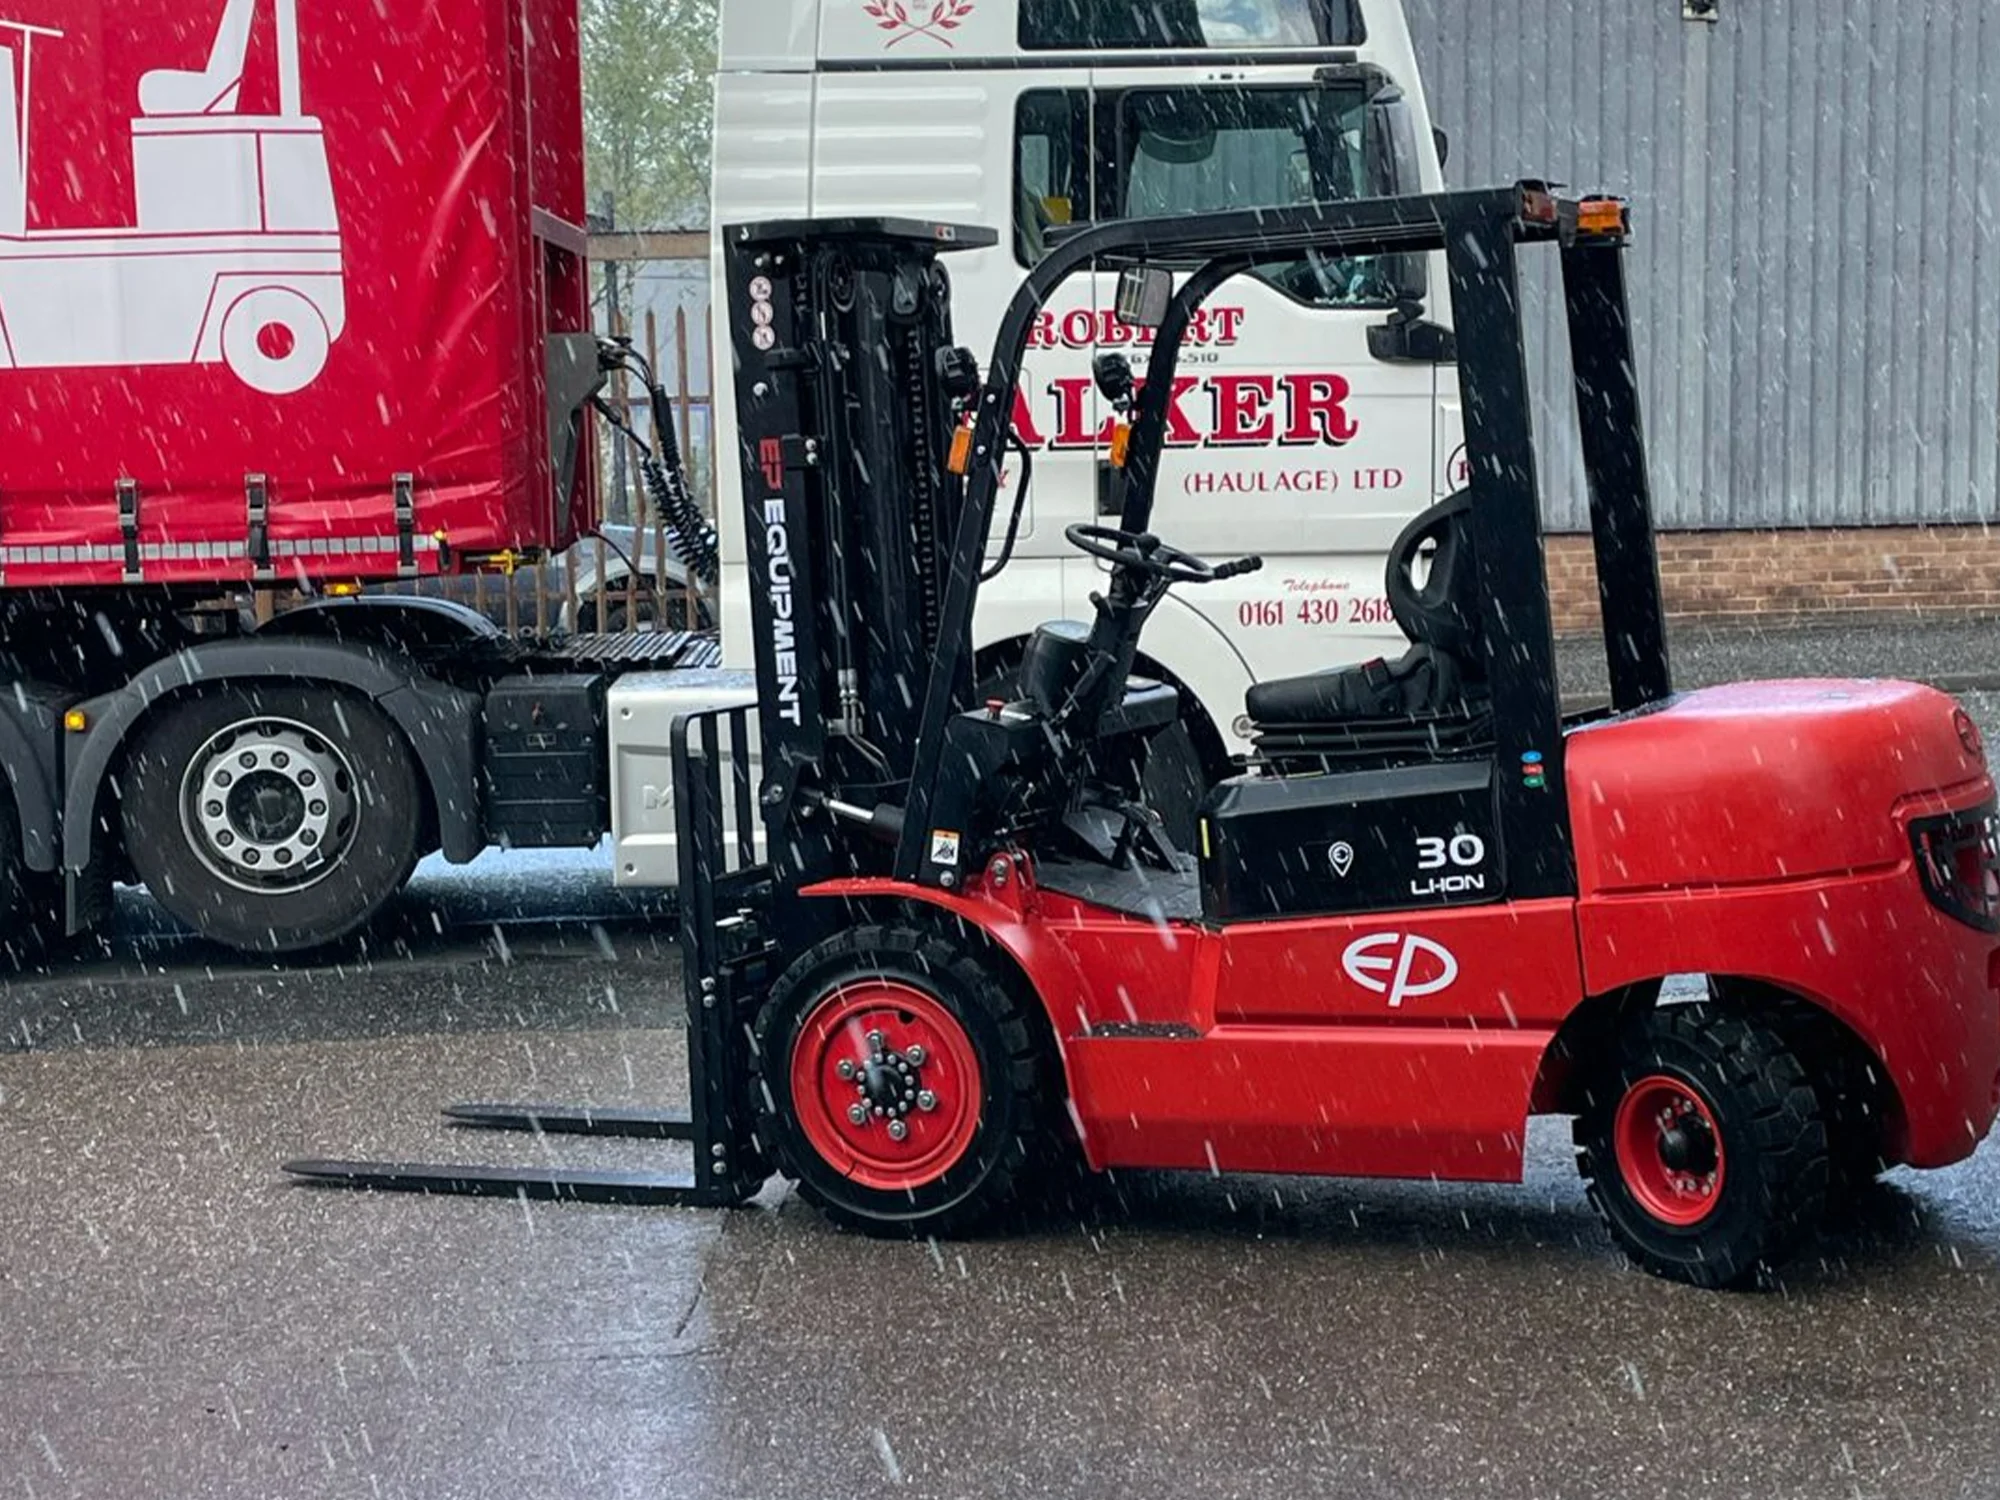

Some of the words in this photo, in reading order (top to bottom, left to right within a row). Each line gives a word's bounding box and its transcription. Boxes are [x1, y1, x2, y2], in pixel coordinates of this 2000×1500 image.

[759, 437, 783, 491] EP
[1184, 470, 1339, 495] (HAULAGE)
[1353, 468, 1403, 490] LTD
[1282, 578, 1351, 593] Telephone
[764, 498, 801, 728] EQUIPMENT
[1238, 600, 1284, 627] 0161
[1297, 598, 1339, 625] 430
[1348, 597, 1395, 623] 2618
[1415, 833, 1485, 870] 30
[1341, 932, 1459, 1008] EP
